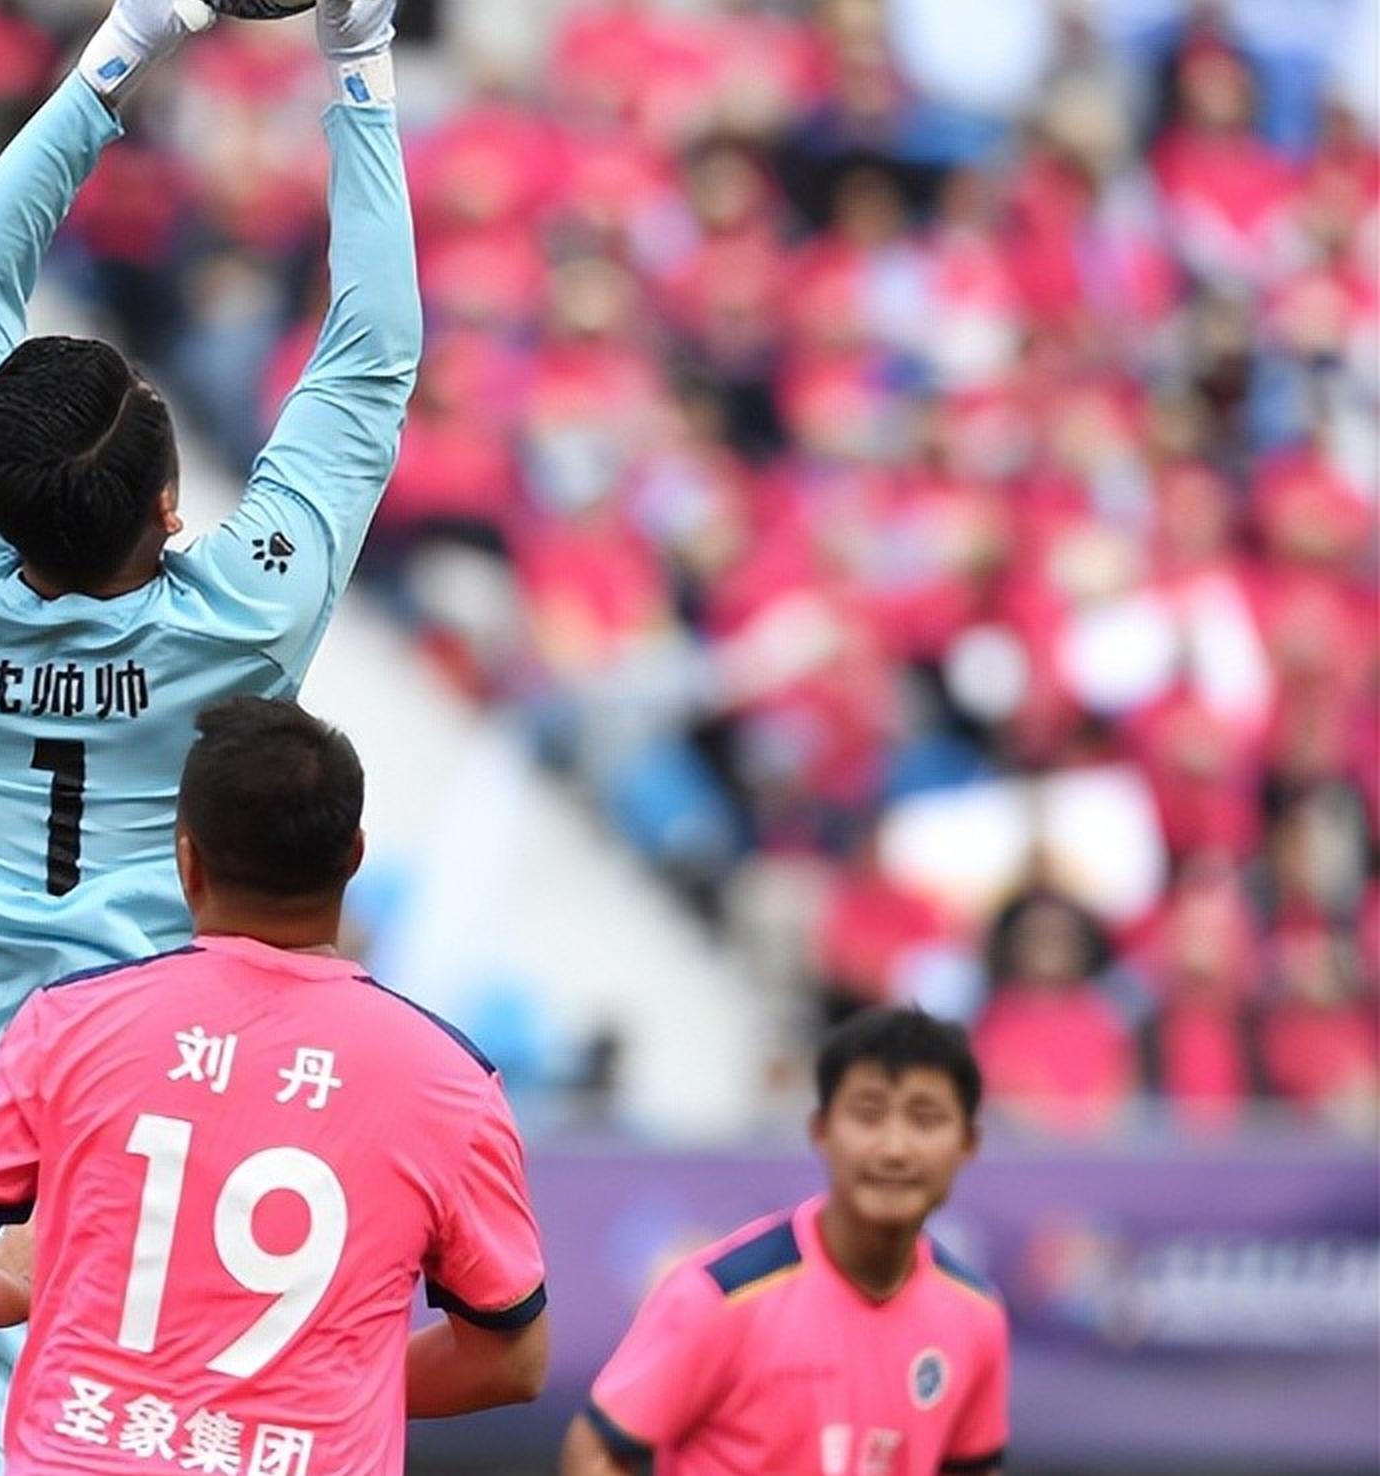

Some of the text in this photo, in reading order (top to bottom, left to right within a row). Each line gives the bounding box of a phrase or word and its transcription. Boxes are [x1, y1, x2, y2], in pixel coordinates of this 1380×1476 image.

[29, 737, 87, 898] 1
[117, 1112, 349, 1380] 19
[54, 1374, 315, 1476] 圣象集团
